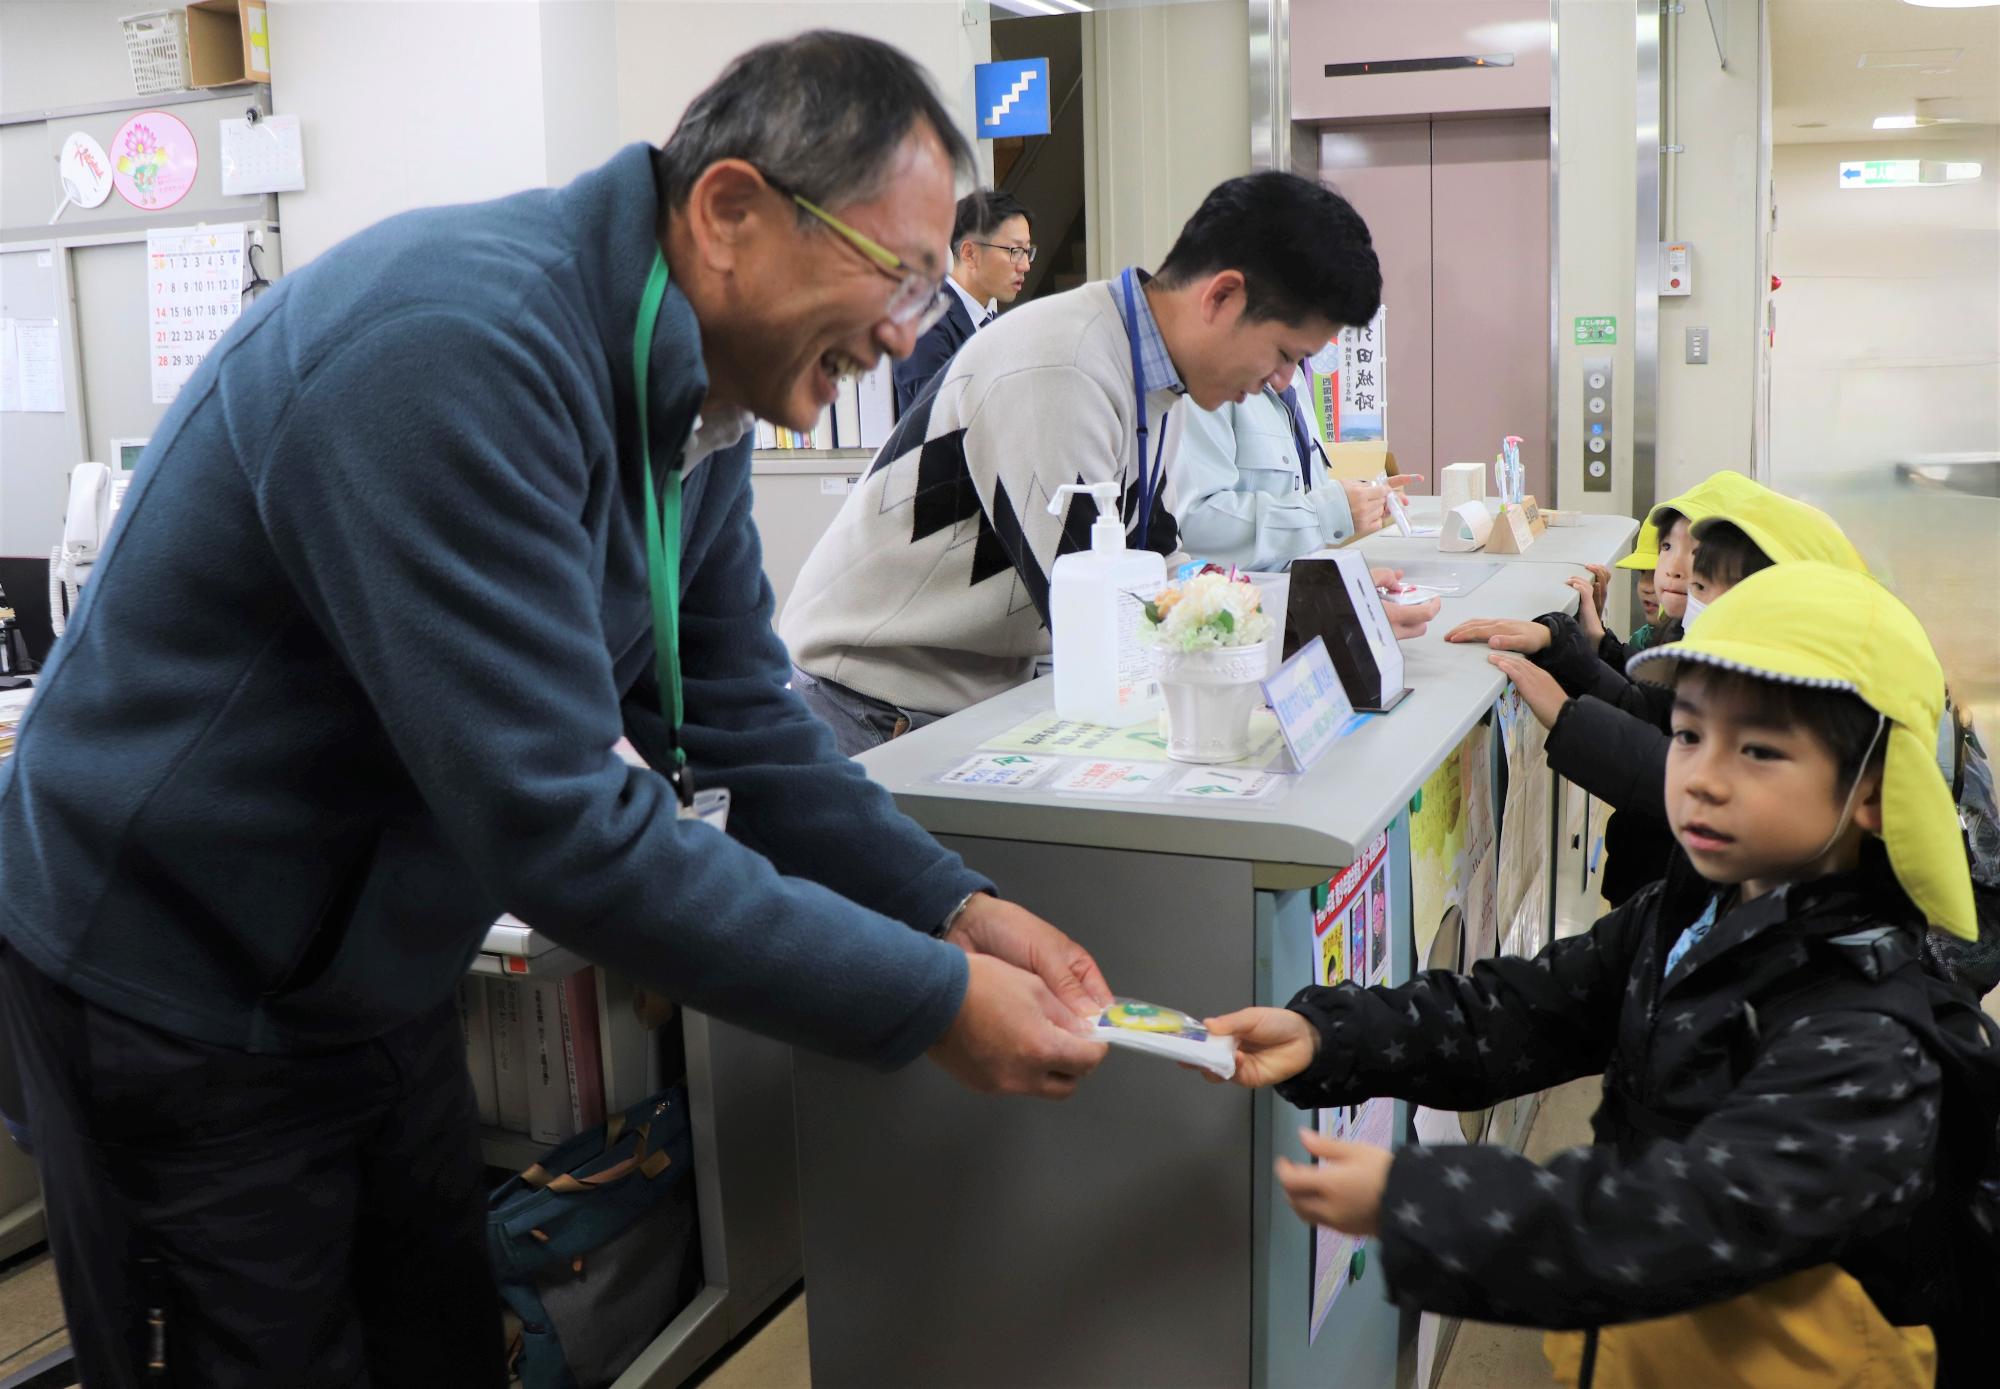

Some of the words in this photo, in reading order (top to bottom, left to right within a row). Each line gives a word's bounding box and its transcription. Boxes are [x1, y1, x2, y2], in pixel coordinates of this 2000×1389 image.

[170, 258, 174, 268] 1
[183, 258, 188, 268] 2
[195, 257, 200, 267] 3
[208, 256, 212, 265] 4
[221, 256, 225, 265] 5
[233, 254, 237, 264] 6
[158, 283, 163, 294] 7
[172, 283, 176, 293] 8
[184, 282, 189, 292] 9
[194, 281, 202, 291] 10
[207, 281, 214, 291] 11
[219, 280, 227, 290] 12
[232, 279, 239, 289] 13
[156, 307, 166, 317] 14
[171, 307, 179, 317] 15
[183, 307, 191, 317] 16
[195, 306, 203, 316] 17
[208, 305, 216, 316] 18
[220, 305, 228, 315] 19
[232, 304, 238, 314] 20
[157, 332, 166, 342] 21
[171, 331, 180, 341] 22
[184, 331, 192, 341] 23
[196, 330, 204, 341] 24
[209, 330, 217, 340] 25
[158, 356, 168, 366] 28
[172, 355, 181, 366] 29
[185, 355, 193, 366] 30
